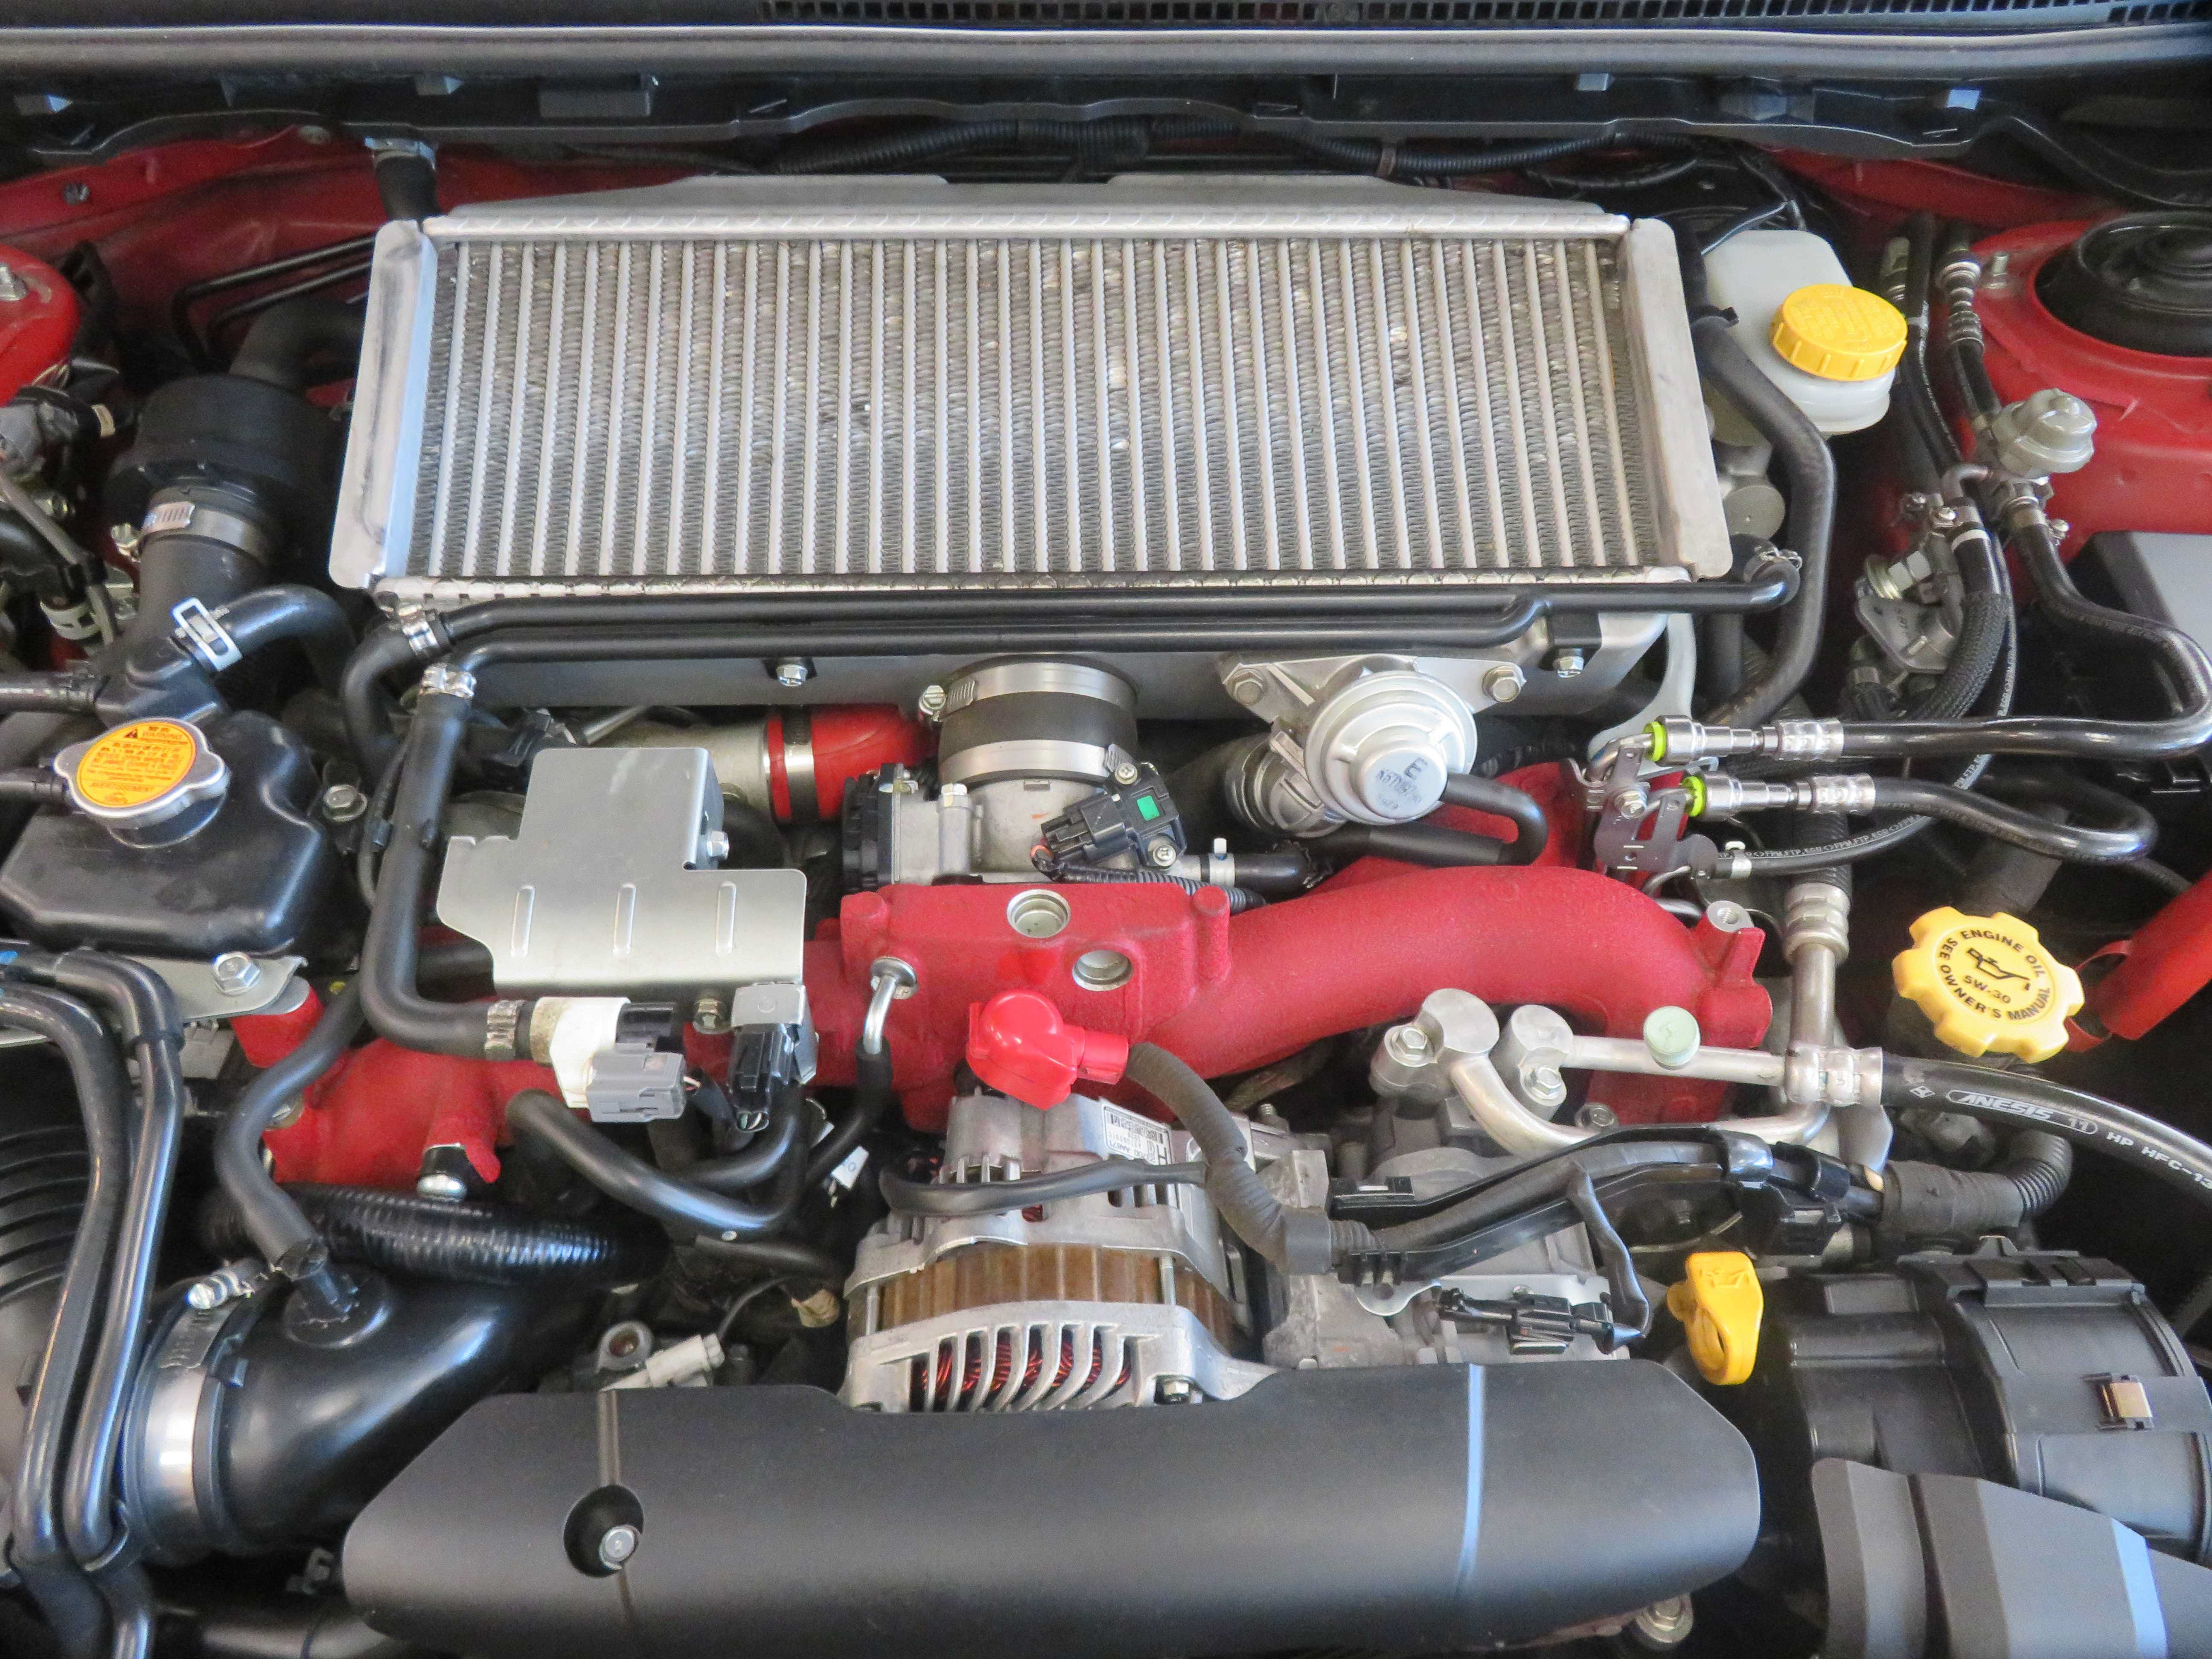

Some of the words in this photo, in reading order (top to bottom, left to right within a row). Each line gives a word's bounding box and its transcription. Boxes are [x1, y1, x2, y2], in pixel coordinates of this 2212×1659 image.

[1938, 938, 1958, 960] SEE
[1961, 929, 2023, 951] ENGINE
[2026, 955, 2046, 977] OIL
[1940, 965, 2002, 1019] OWNER'S
[1963, 975, 2011, 1004] 5W-30
[2007, 987, 2051, 1020] MANUAL
[1958, 1094, 2054, 1120] ANESIS
[2106, 1132, 2134, 1146] HP
